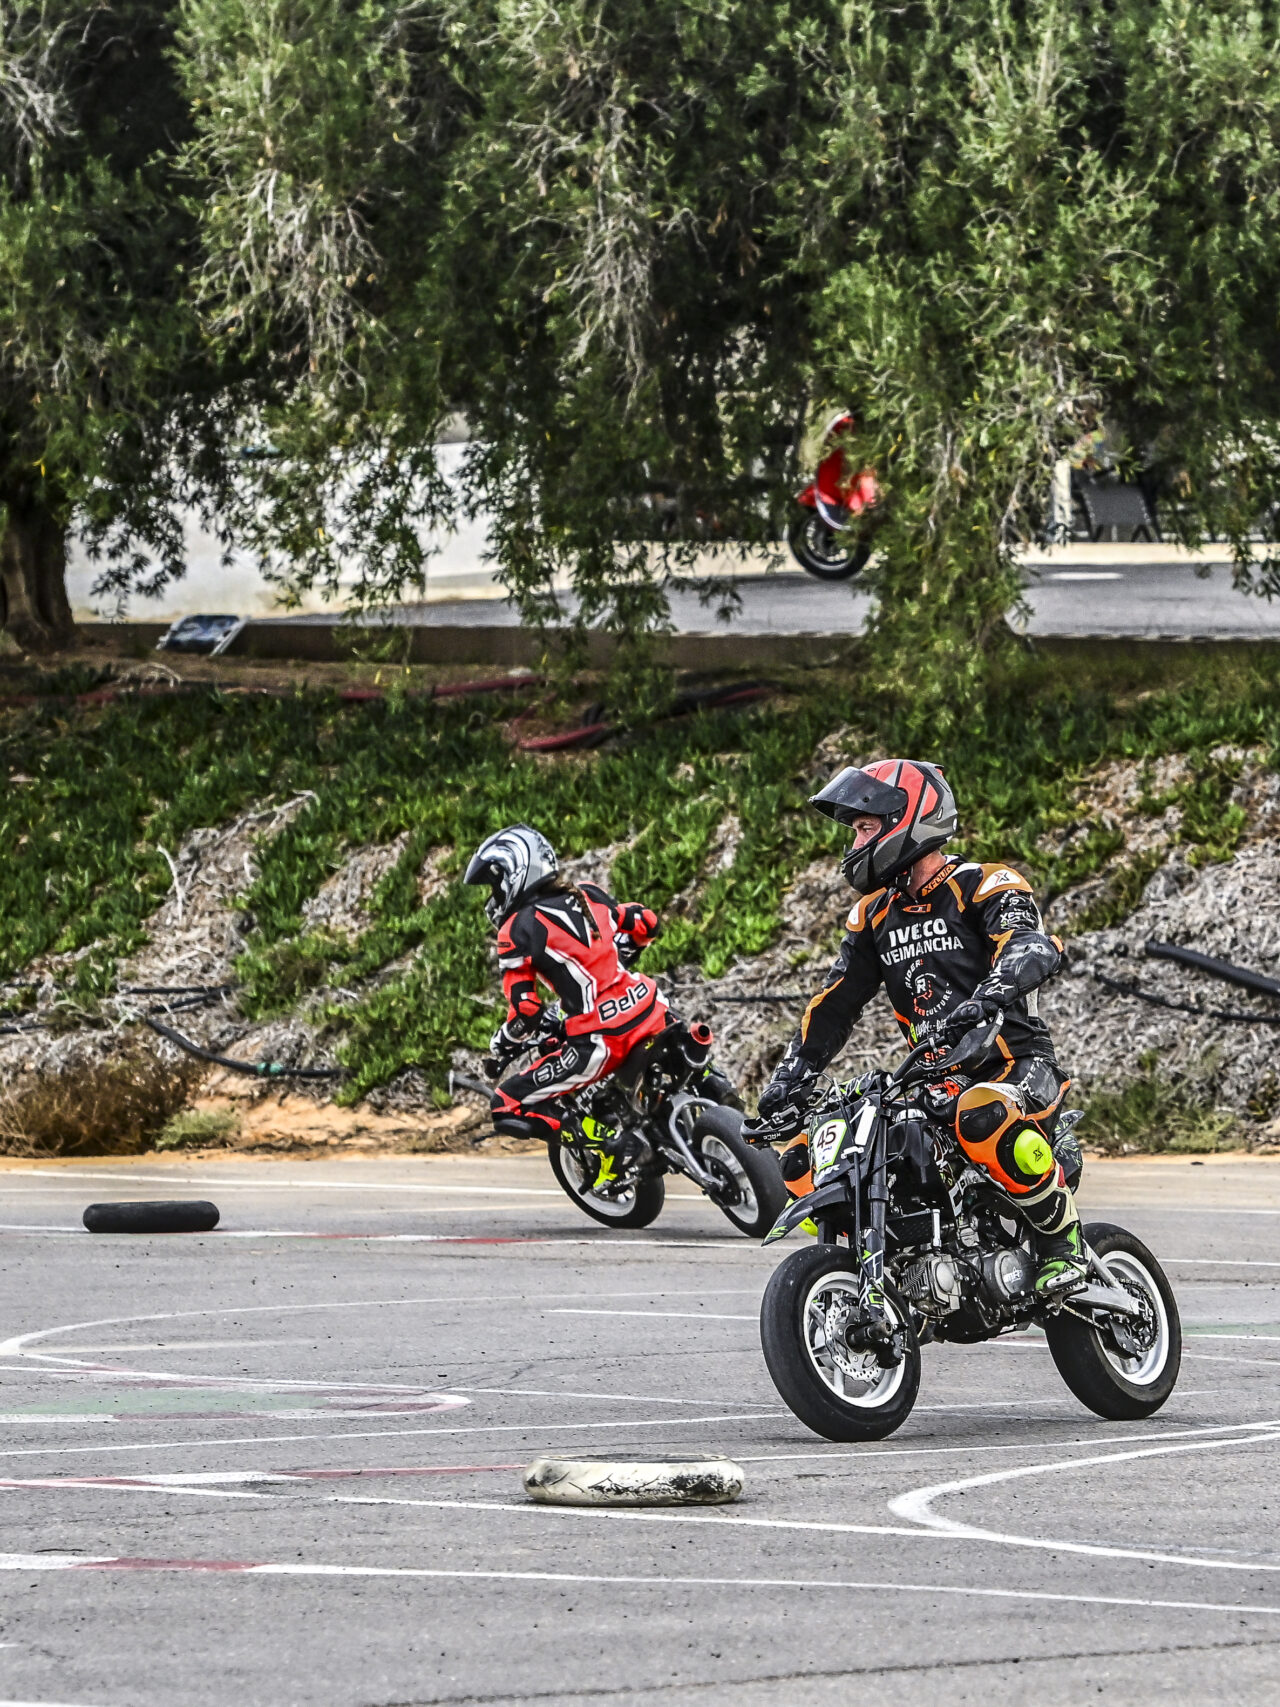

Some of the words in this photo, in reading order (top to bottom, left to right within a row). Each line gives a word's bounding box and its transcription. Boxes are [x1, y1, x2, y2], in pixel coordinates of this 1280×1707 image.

[923, 866, 953, 893] XFOUR
[888, 918, 948, 948] IVECO
[880, 936, 965, 966] VEIMANCHA
[597, 981, 650, 1023] Bela
[925, 989, 953, 1017] CULTURE
[816, 1124, 837, 1149] 45
